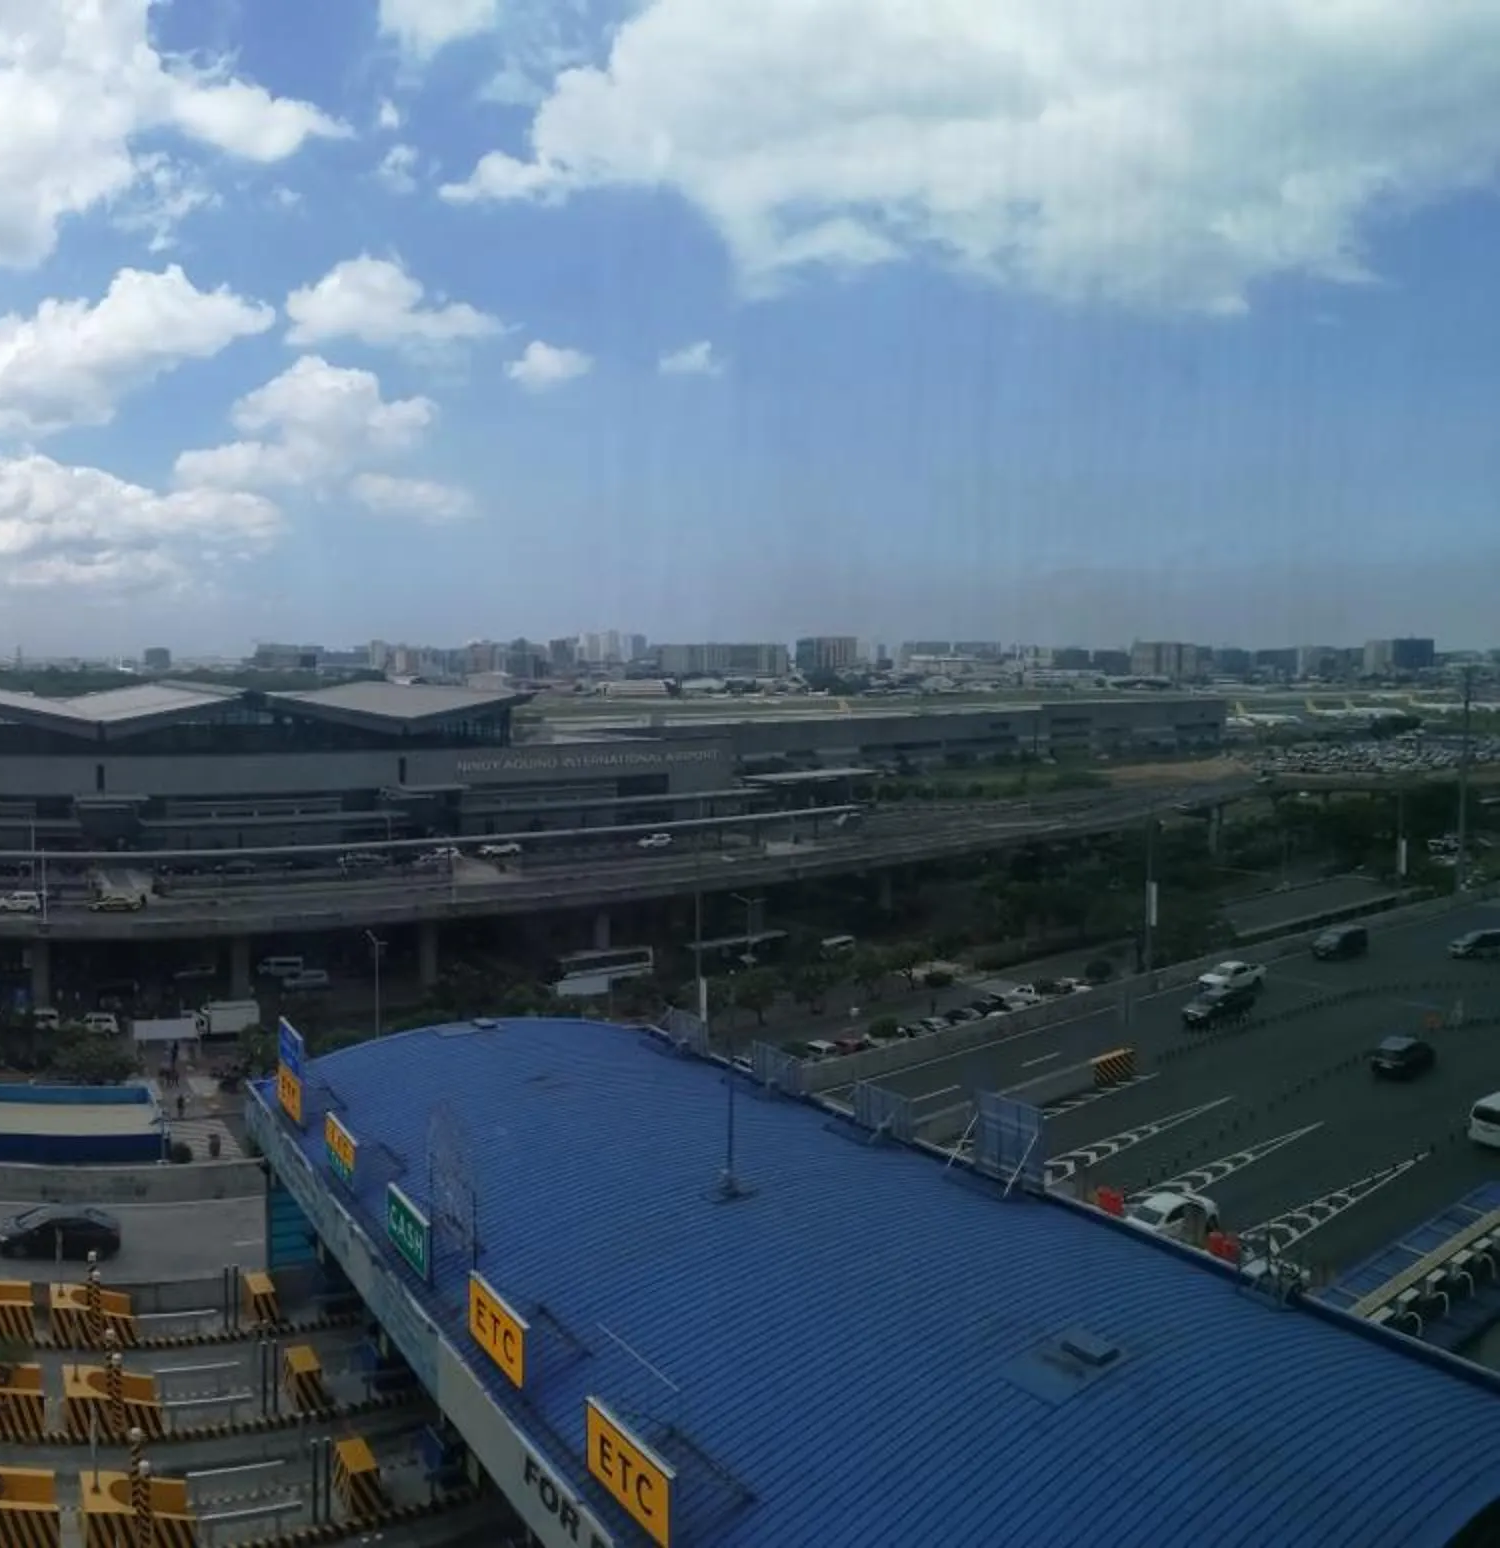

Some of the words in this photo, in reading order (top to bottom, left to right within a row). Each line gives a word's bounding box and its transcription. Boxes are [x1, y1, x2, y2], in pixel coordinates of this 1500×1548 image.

[503, 757, 557, 770] AQUINO
[563, 753, 662, 768] INTERNATIONAL
[665, 749, 720, 763] AIRPORT
[390, 1205, 424, 1260] CASH
[475, 1296, 516, 1364] ETC
[523, 1456, 581, 1542] FOR
[599, 1434, 653, 1516] ETC
